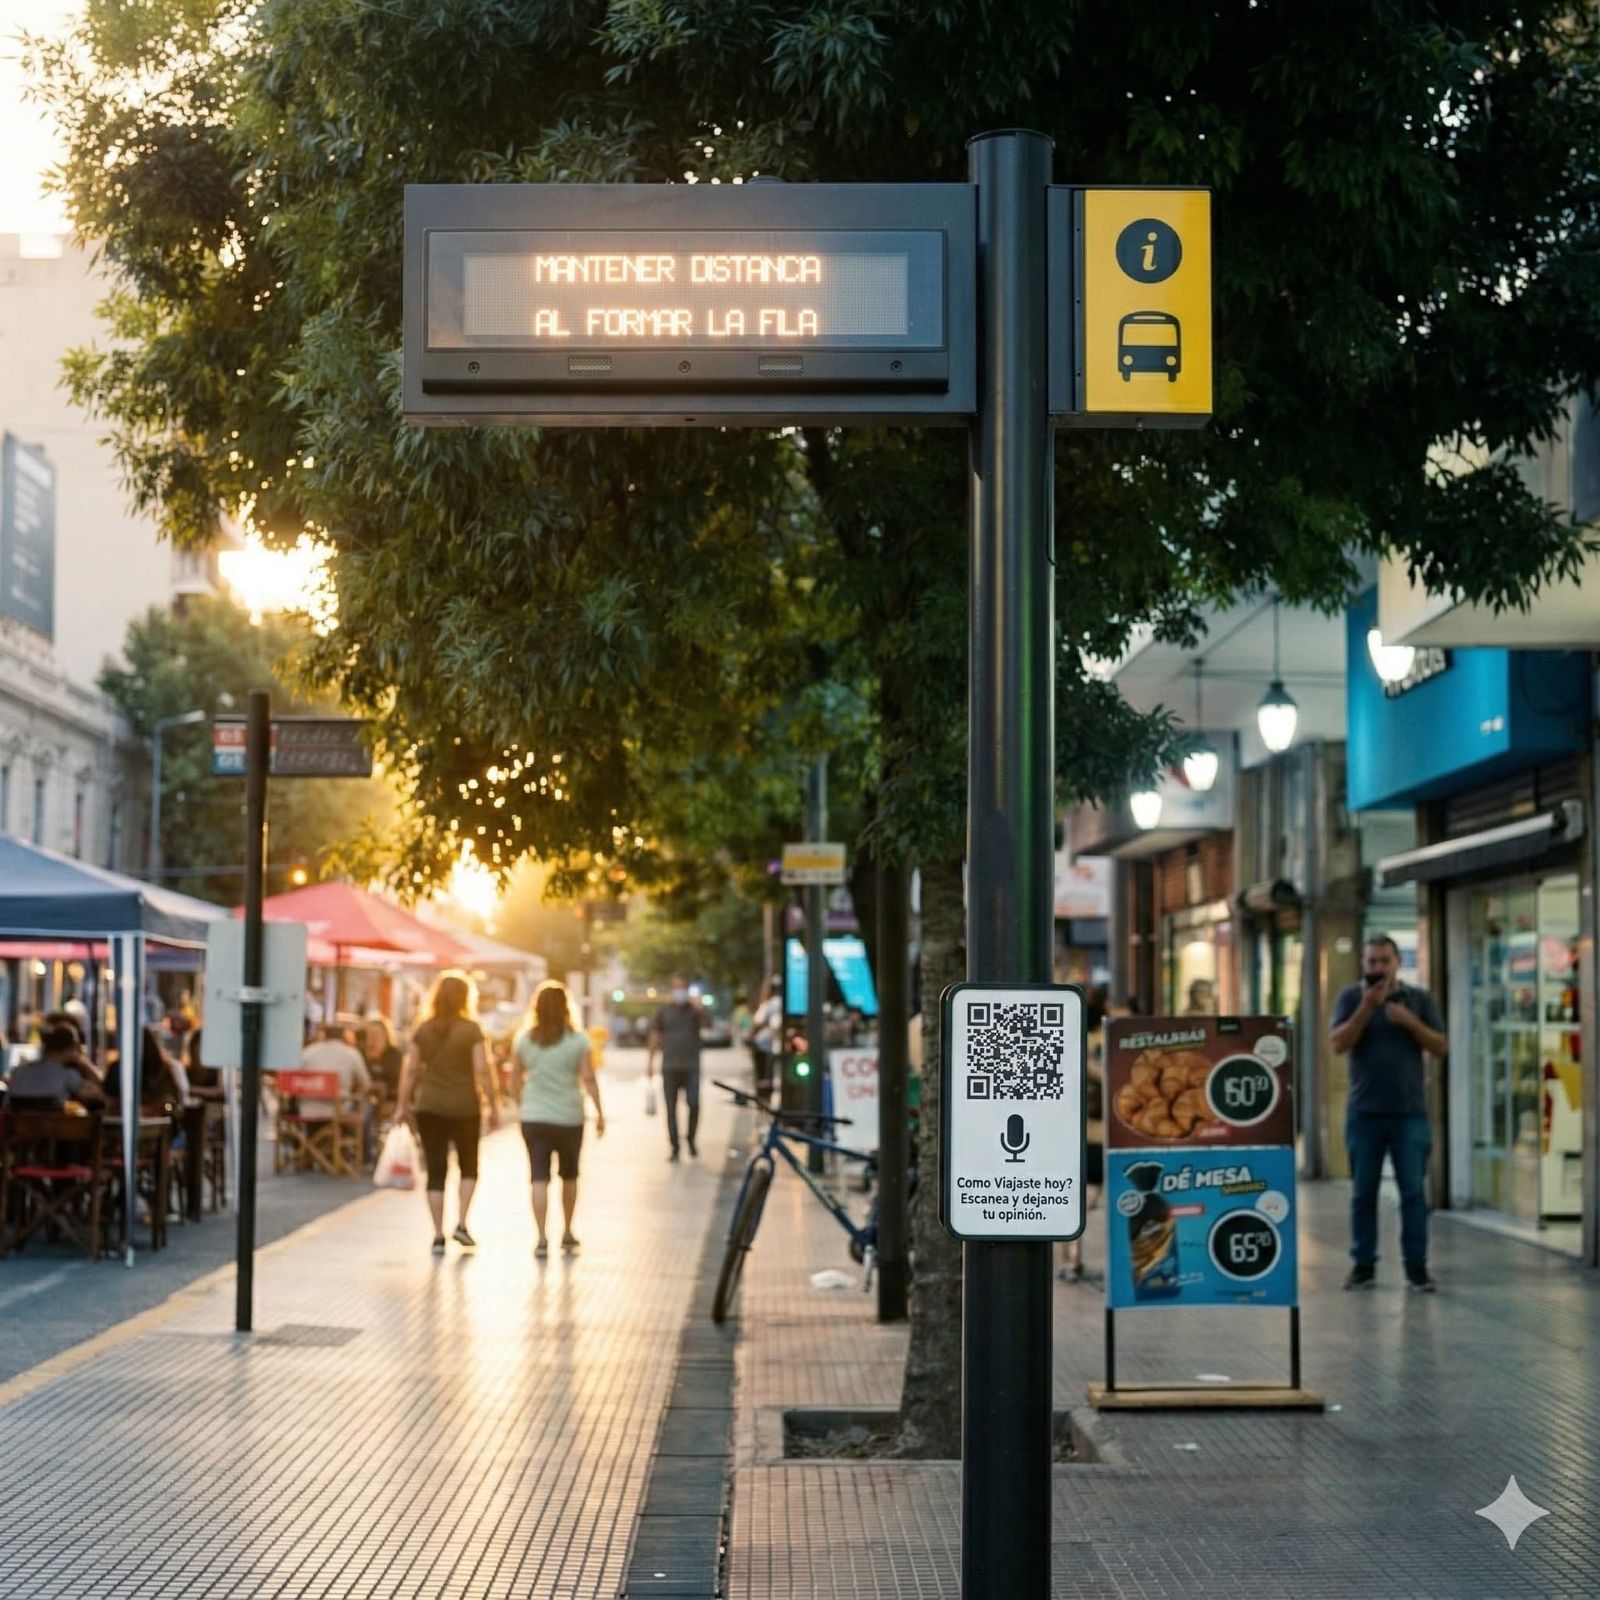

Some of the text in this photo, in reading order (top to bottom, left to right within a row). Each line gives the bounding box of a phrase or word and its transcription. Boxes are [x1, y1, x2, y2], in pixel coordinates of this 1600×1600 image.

[536, 254, 676, 282] MANTENER
[535, 308, 571, 336] AL
[586, 308, 692, 336] FORMAR
[708, 308, 745, 336] LA
[957, 1176, 1073, 1192] Como Viajaste hoy?
[1163, 1166, 1252, 1191] DÉ MESA
[960, 1193, 1069, 1208] Escanea y dejanos
[983, 1208, 1047, 1223] tu opinión.
